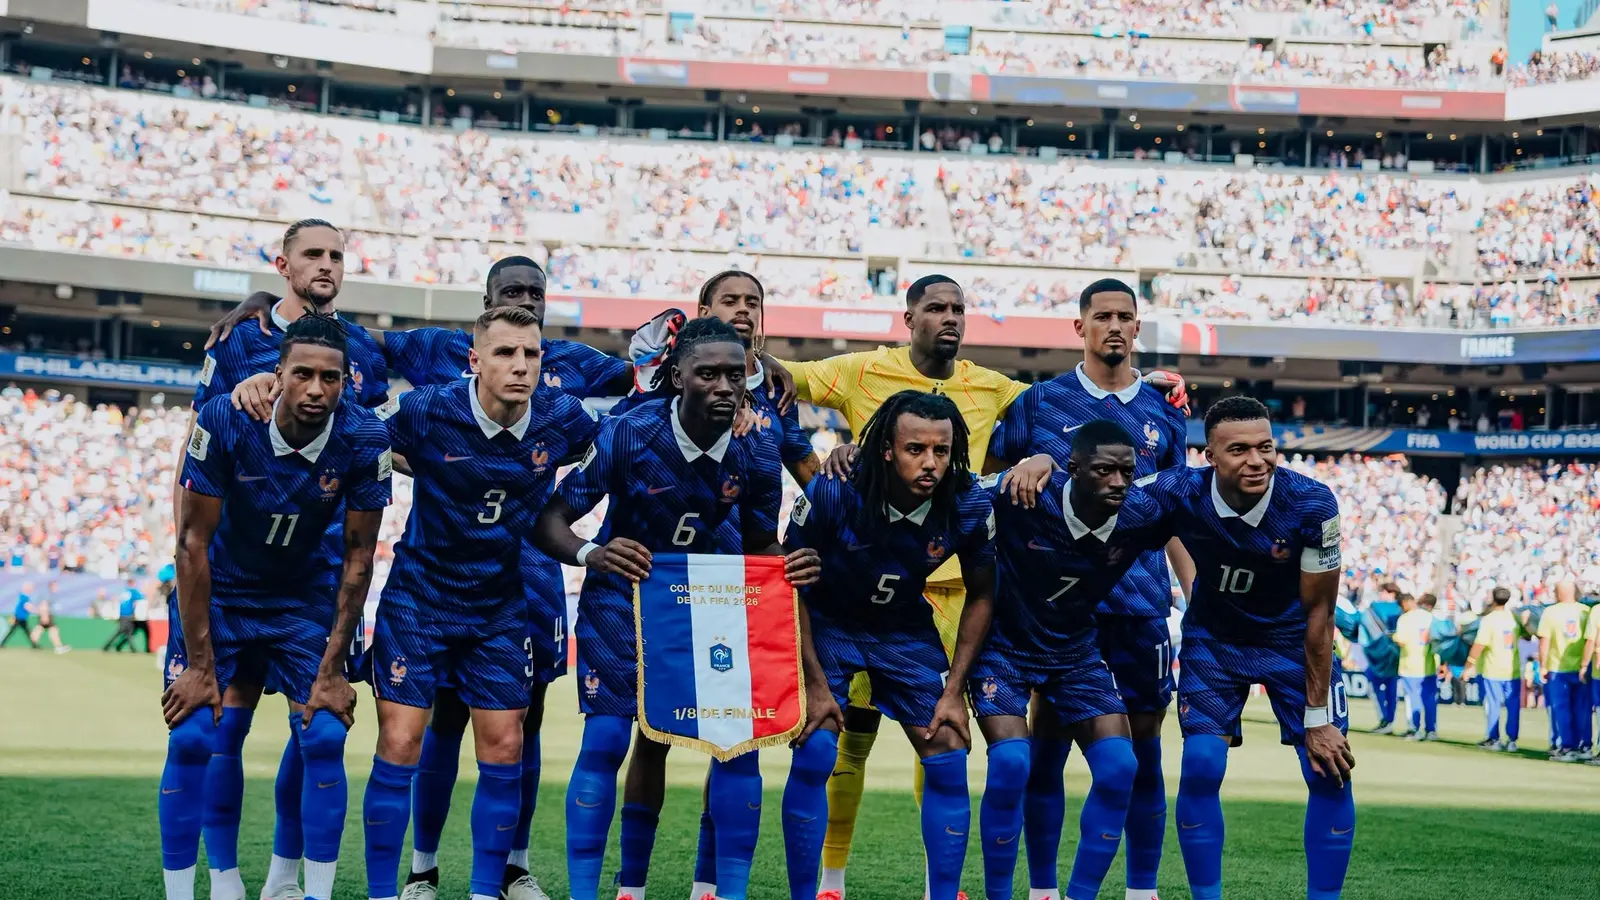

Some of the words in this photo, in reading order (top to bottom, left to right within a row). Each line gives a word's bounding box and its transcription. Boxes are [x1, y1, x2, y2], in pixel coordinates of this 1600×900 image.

[1460, 336, 1516, 358] FRANCE
[1407, 433, 1440, 448] FIFA
[1474, 434, 1529, 449] WORLD
[1530, 434, 1563, 449] CUP
[477, 488, 507, 524] 3
[264, 513, 300, 547] 11
[671, 512, 700, 546] 6
[669, 584, 705, 593] COUPE
[708, 585, 722, 594] DU
[725, 585, 762, 594] MONDE
[871, 573, 901, 604] 5
[1046, 576, 1080, 602] 7
[1219, 564, 1255, 594] 10
[677, 596, 691, 605] DE
[693, 596, 707, 605] LA
[709, 597, 730, 606] FIFA
[733, 597, 759, 606] 2026
[554, 616, 565, 653] 4
[523, 636, 534, 678] 3
[672, 706, 697, 720] 1/8
[700, 707, 720, 719] DE
[723, 707, 776, 719] FINALE
[1327, 681, 1347, 723] 10
